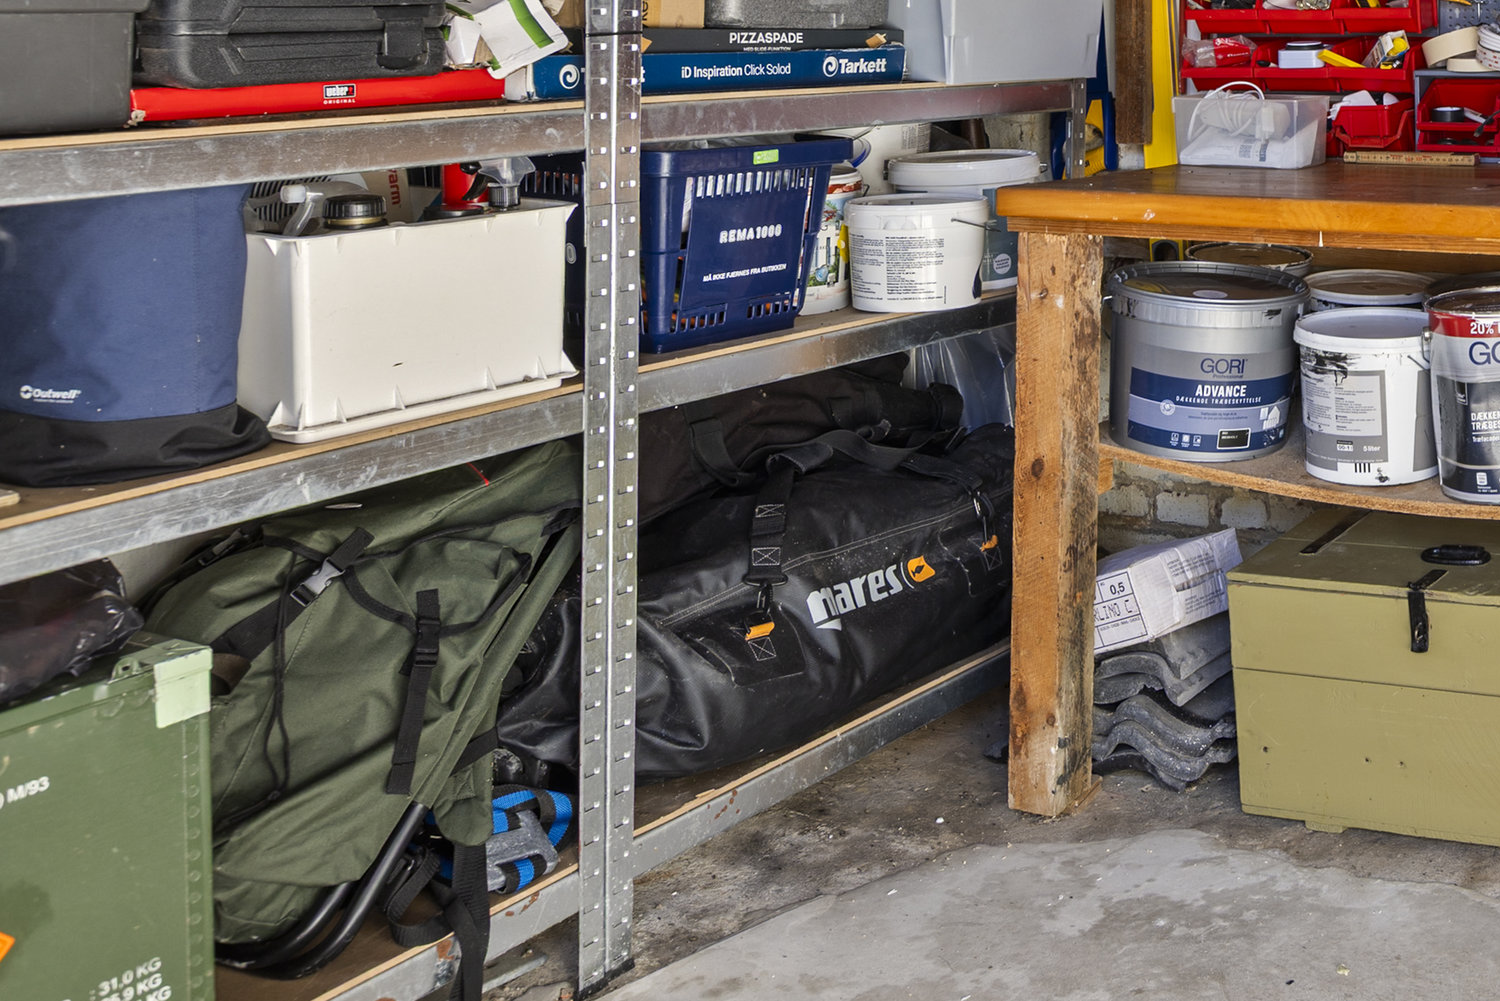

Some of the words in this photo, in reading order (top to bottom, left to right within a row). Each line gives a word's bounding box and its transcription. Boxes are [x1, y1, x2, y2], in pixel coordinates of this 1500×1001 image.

[729, 31, 804, 44] PIZZASPADE
[681, 66, 692, 79] iD
[693, 65, 743, 80] Inspiration
[743, 63, 766, 76] Click
[838, 58, 887, 75] Tarkett
[719, 226, 755, 244] REMA
[755, 223, 783, 240] 1000
[1470, 322, 1495, 335] 20%
[1200, 358, 1246, 374] GORI
[32, 388, 77, 399] Outwell
[1195, 384, 1248, 398] ADVANCE
[806, 564, 904, 624] mares
[1109, 581, 1126, 597] 0,5
[6, 776, 51, 804] M/93
[98, 969, 135, 997] 31.0
[135, 956, 162, 979] KG
[136, 973, 163, 996] KG
